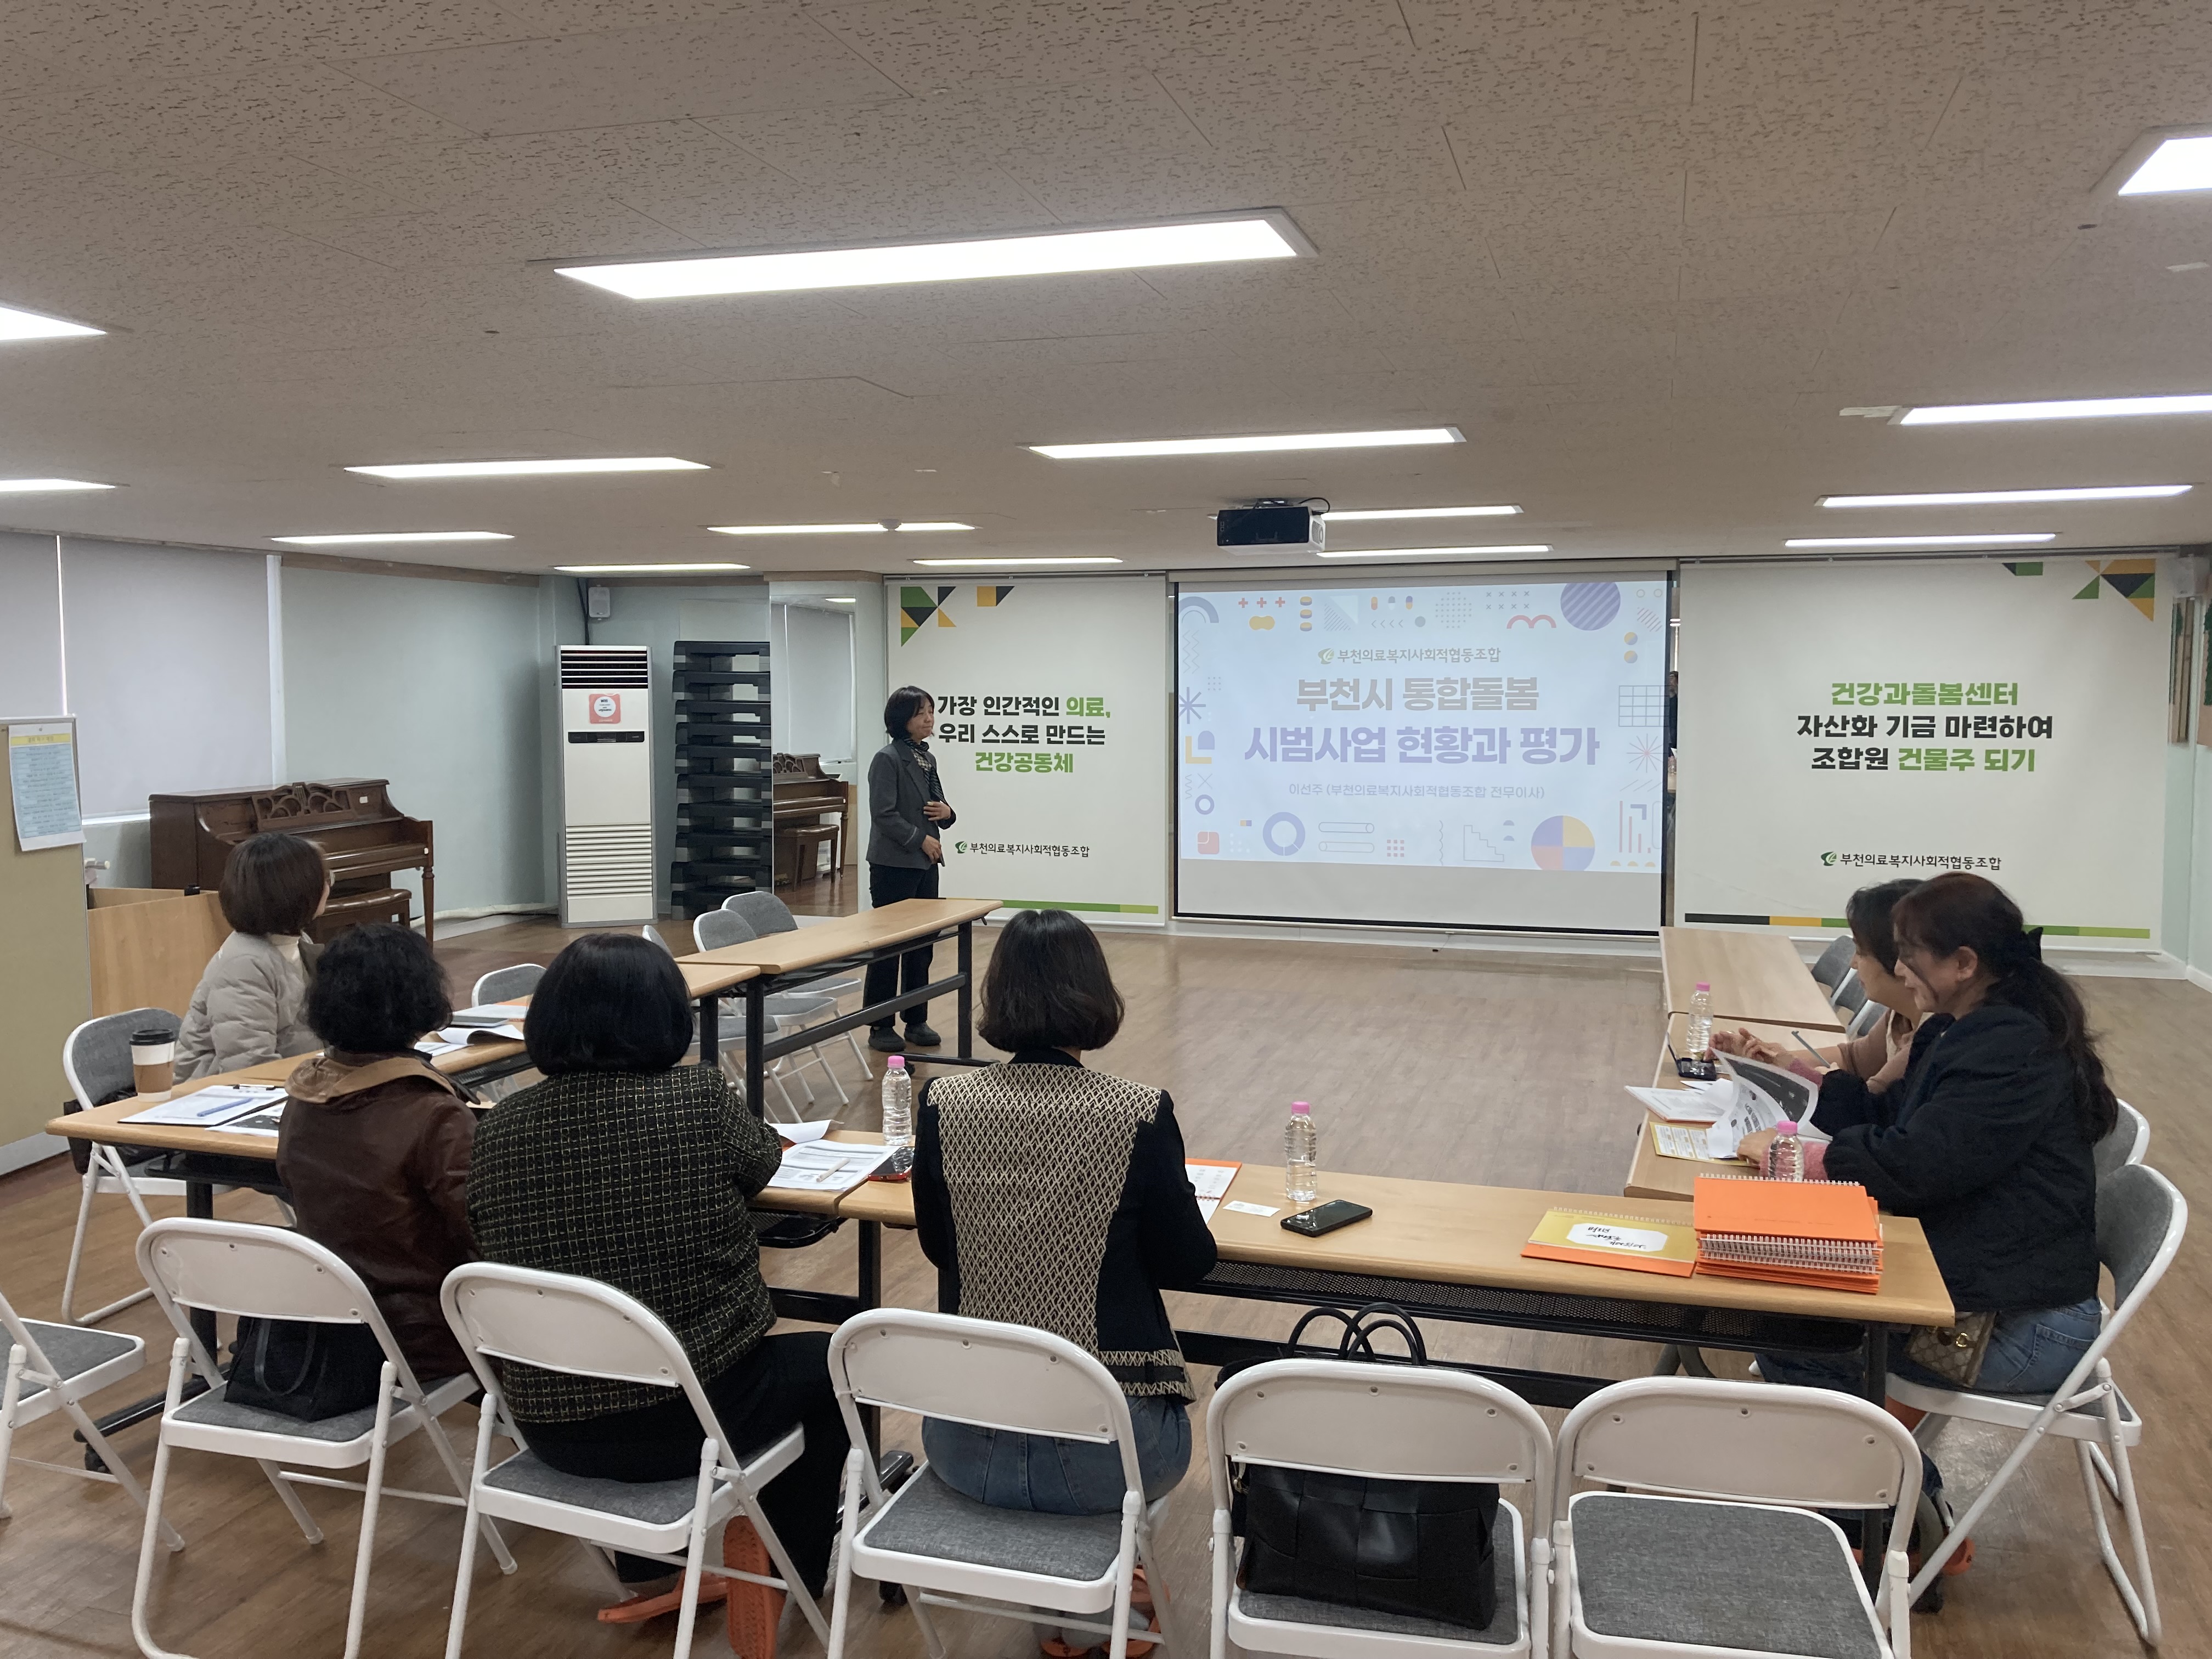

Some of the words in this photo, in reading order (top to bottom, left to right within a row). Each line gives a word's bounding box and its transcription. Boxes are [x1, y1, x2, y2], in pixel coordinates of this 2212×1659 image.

[1337, 647, 1501, 664] 부천의료복지사회적협동조합
[1297, 678, 1393, 711] 부천시
[1402, 677, 1539, 710] 통합돌봄
[1831, 682, 2018, 706] 건강과돌봄센터
[938, 696, 977, 716] 가장
[983, 696, 1059, 716] 인간적인
[1066, 697, 1110, 718] 의료,
[939, 723, 975, 743] 우리
[981, 724, 1039, 744] 스스로
[1046, 725, 1105, 745] 만드는
[1797, 715, 1878, 738] 자산화
[1886, 715, 1936, 738] 기금
[1945, 715, 2053, 739] 마련하여
[1244, 726, 1386, 763] 시범사업
[1396, 725, 1511, 764] 현황과
[1520, 726, 1600, 765] 평가
[975, 752, 1074, 773] 건강공동체
[1812, 747, 1888, 770] 조합원
[1898, 748, 1975, 771] 건물주
[1984, 748, 2035, 772] 되기
[1289, 783, 1323, 795] 이선주
[1325, 784, 1487, 798] (부천의료복지사회적협동조합
[1490, 785, 1545, 799] 전무이사)
[969, 842, 1090, 858] 부천의료복지사회적협동조합
[1839, 853, 2002, 871] 부천의료복지사회적협동조합
